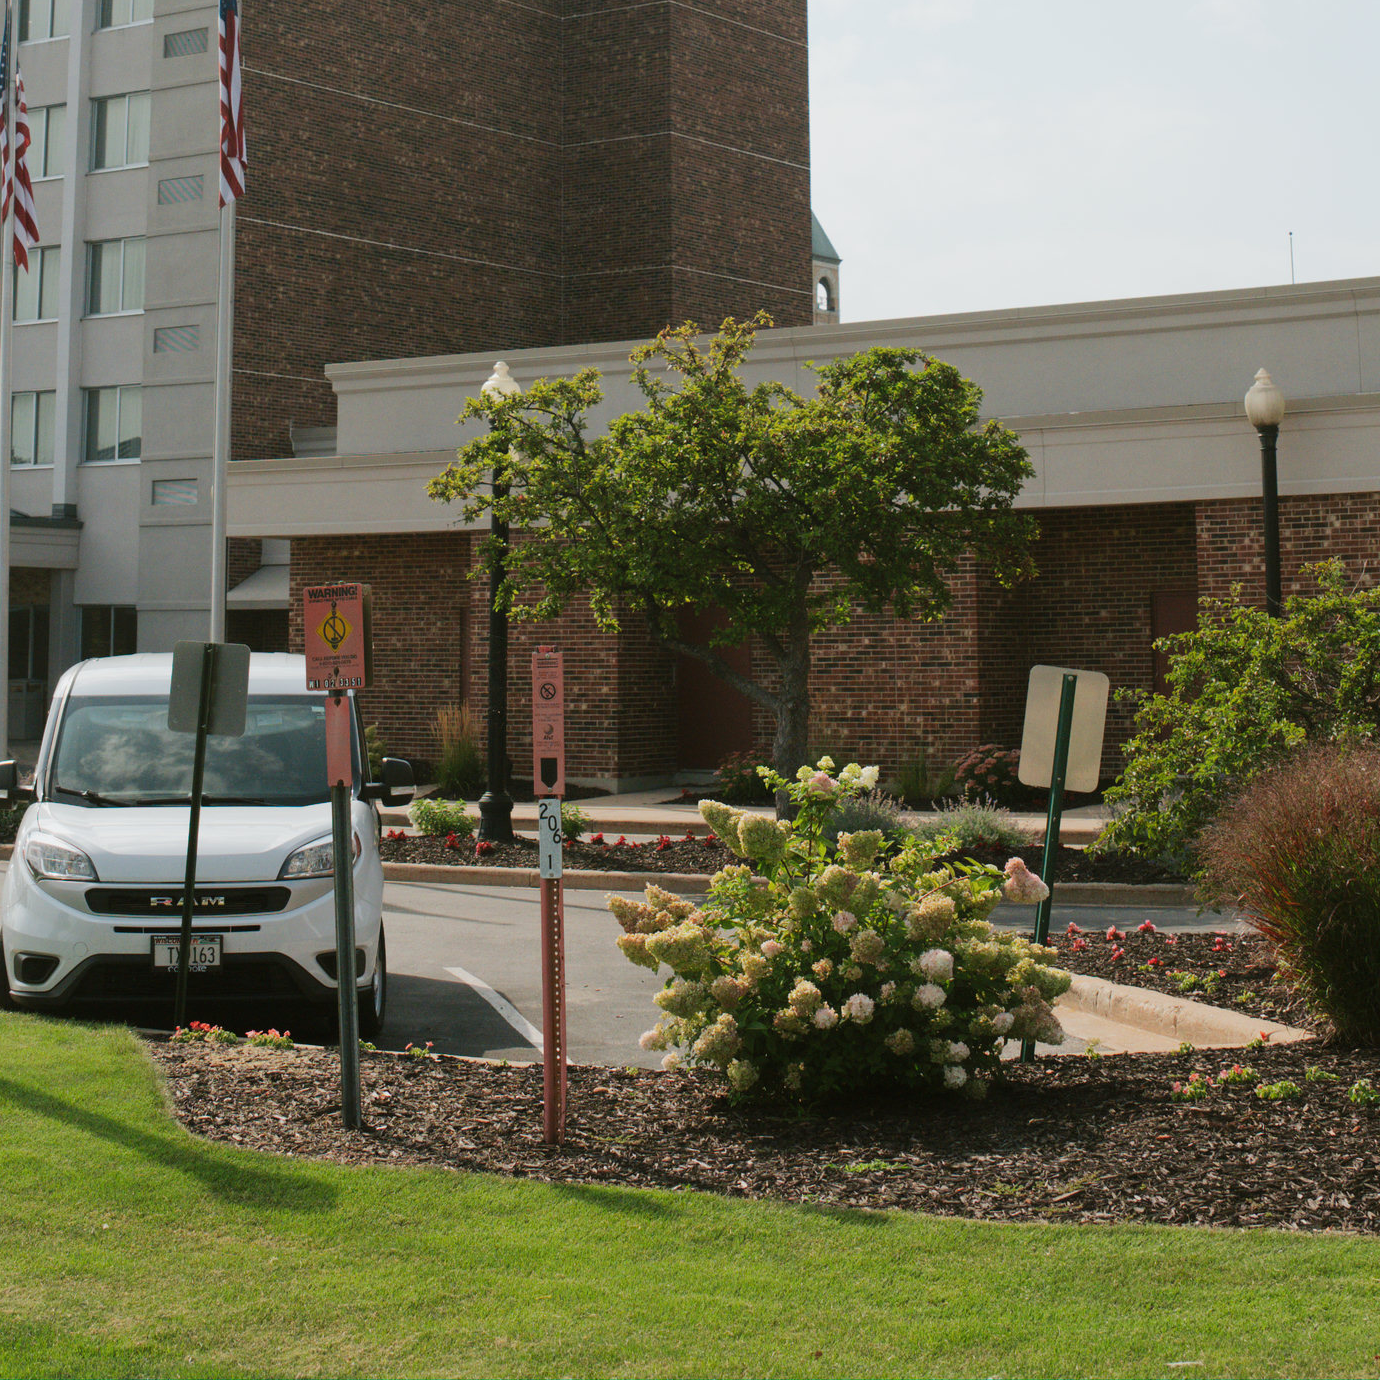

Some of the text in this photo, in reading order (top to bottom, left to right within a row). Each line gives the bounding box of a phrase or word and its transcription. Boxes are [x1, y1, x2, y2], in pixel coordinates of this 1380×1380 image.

[307, 586, 358, 599] WARNING!
[150, 896, 225, 906] RAM
[167, 946, 215, 964] TX163
